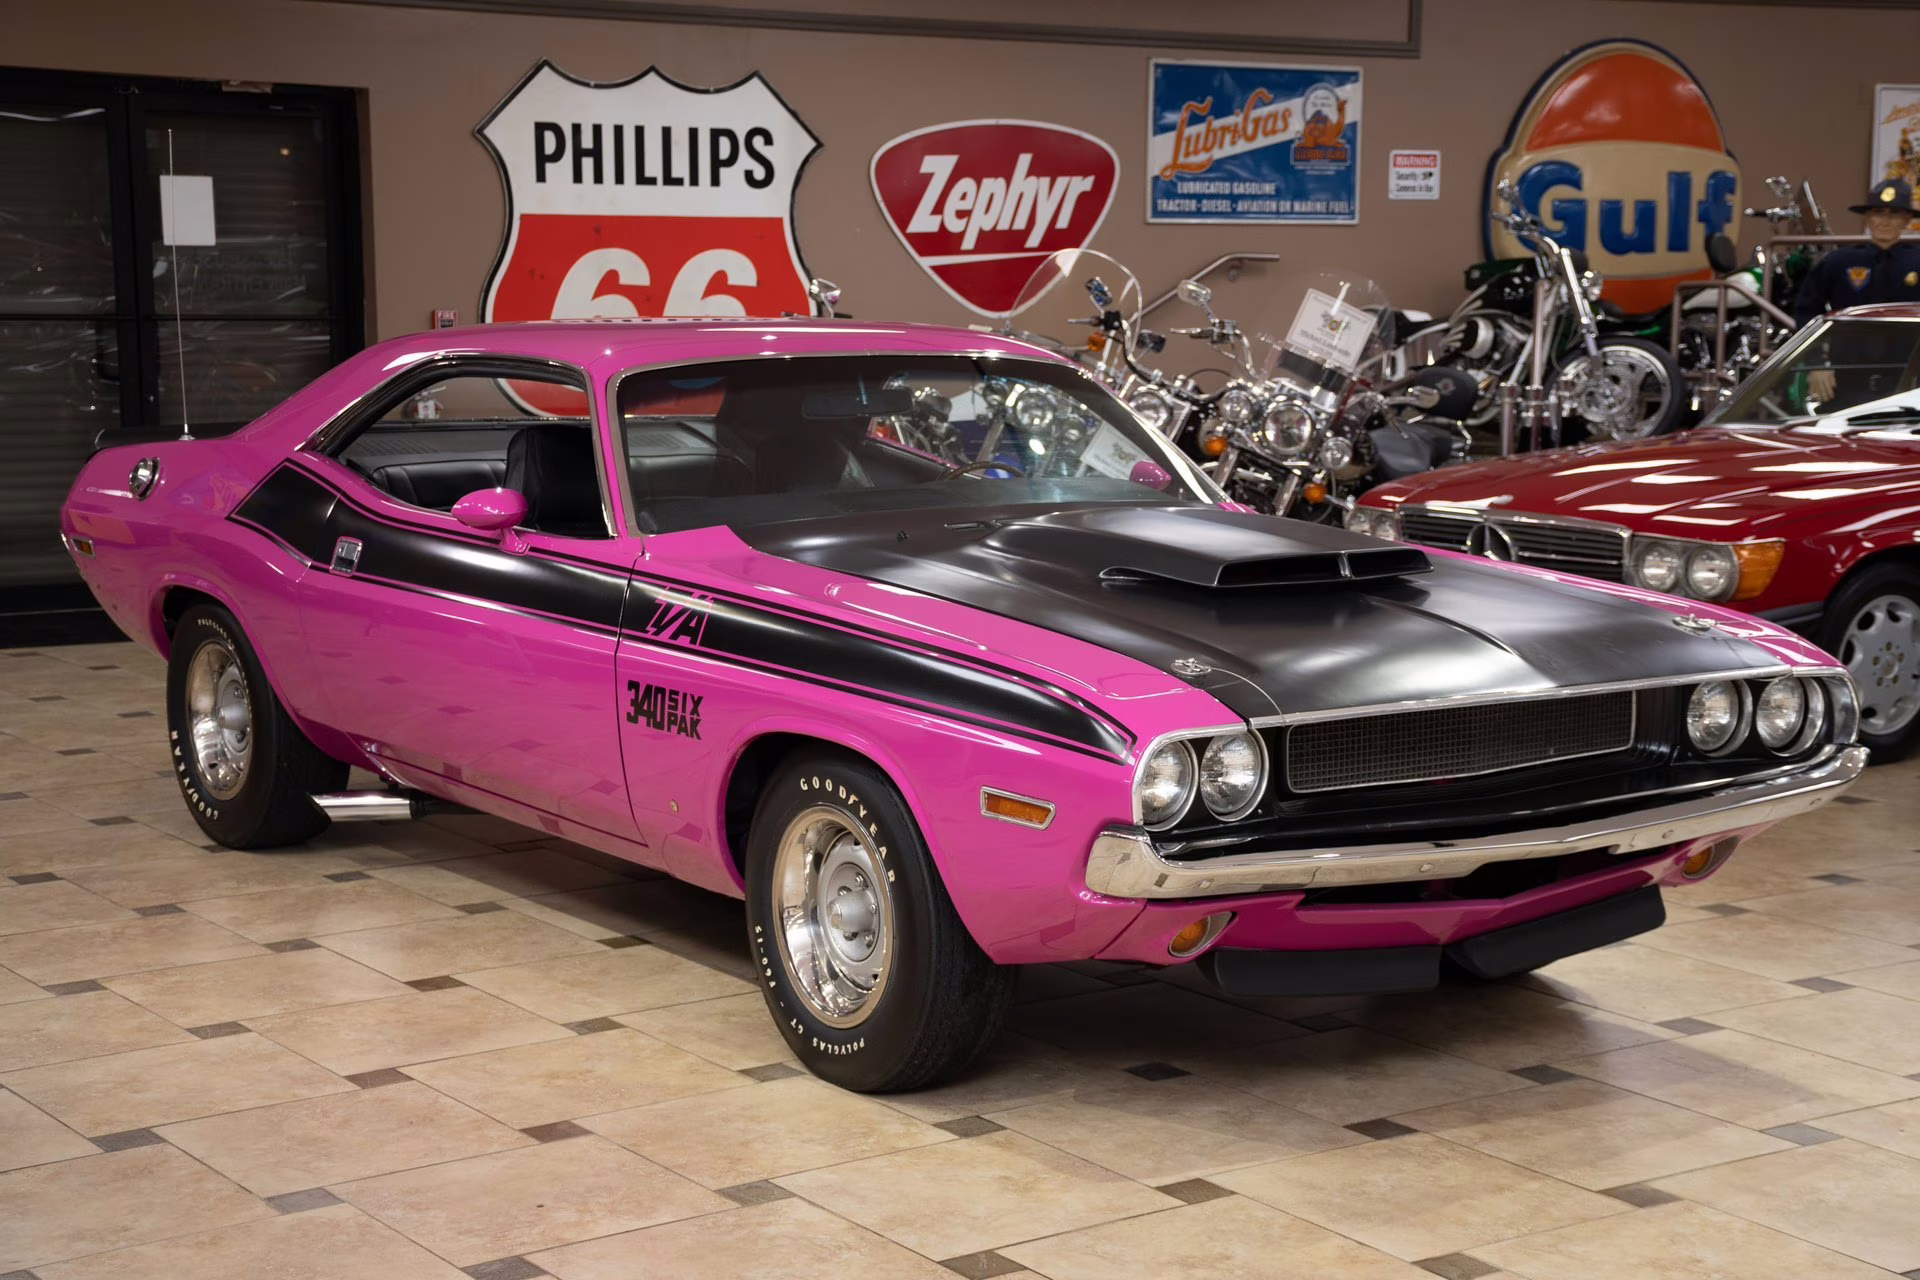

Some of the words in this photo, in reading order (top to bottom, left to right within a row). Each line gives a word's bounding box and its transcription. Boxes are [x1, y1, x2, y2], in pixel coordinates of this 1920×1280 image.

[534, 121, 775, 189] PHILLIPS
[905, 152, 1095, 250] Zephyr
[1511, 160, 1737, 257] Gulf
[626, 680, 667, 730] 340
[666, 711, 702, 740] PAK
[667, 689, 704, 717] SIX
[800, 776, 896, 882] GOODYEAR
[812, 1037, 866, 1055] POLYGLAS
